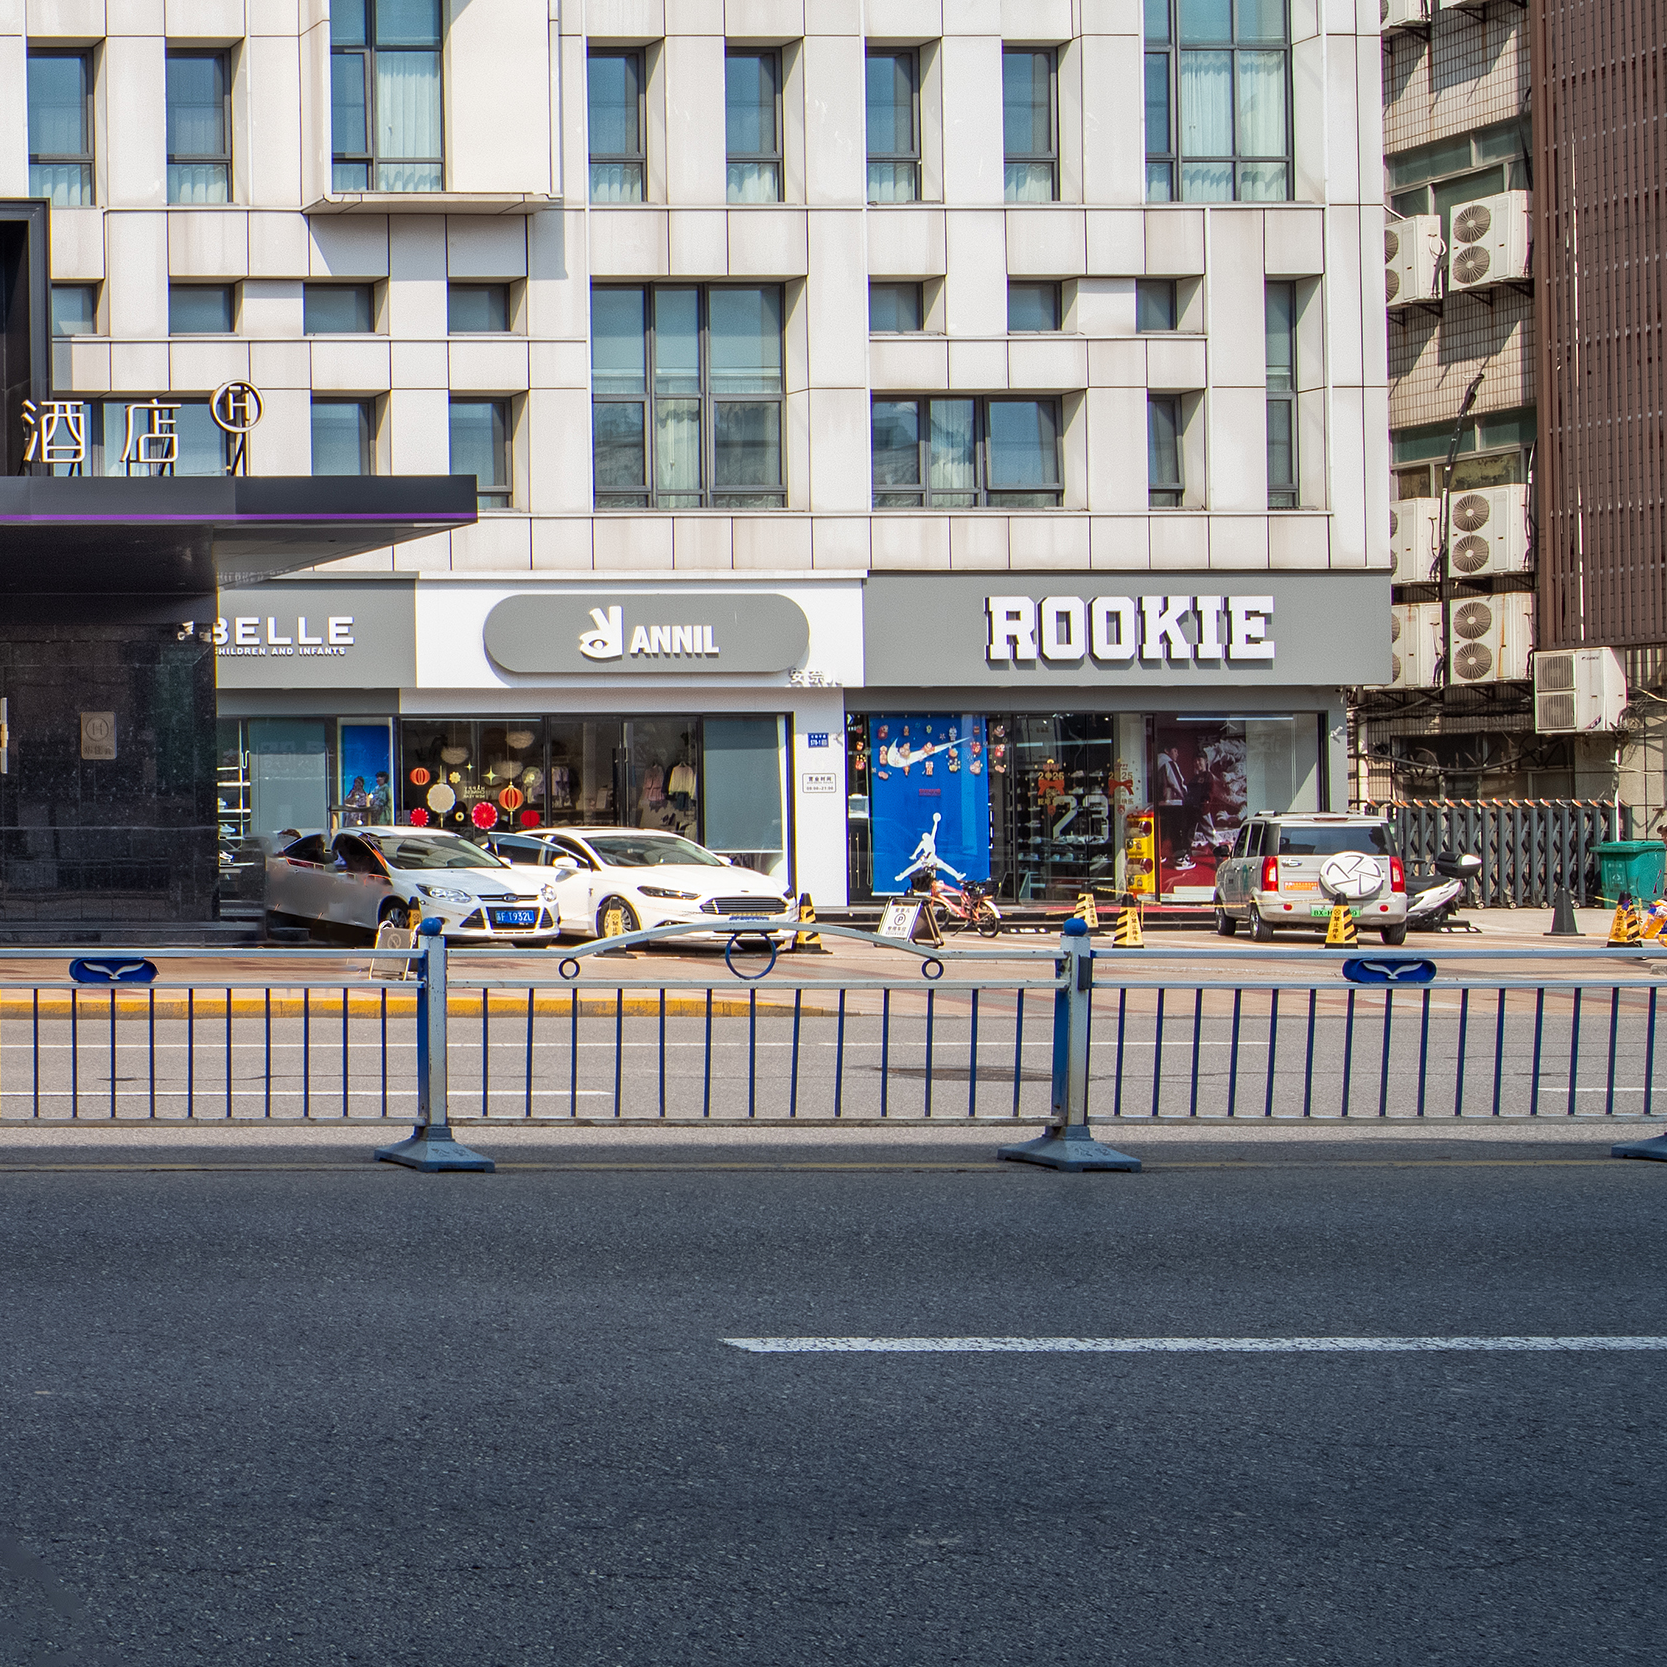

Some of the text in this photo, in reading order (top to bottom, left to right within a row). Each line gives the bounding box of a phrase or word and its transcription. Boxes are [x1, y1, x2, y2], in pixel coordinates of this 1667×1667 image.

[630, 626, 720, 658] ANNIL
[984, 596, 1275, 660] ROOKIE
[271, 647, 294, 657] AND
[299, 647, 347, 656] INFANTS
